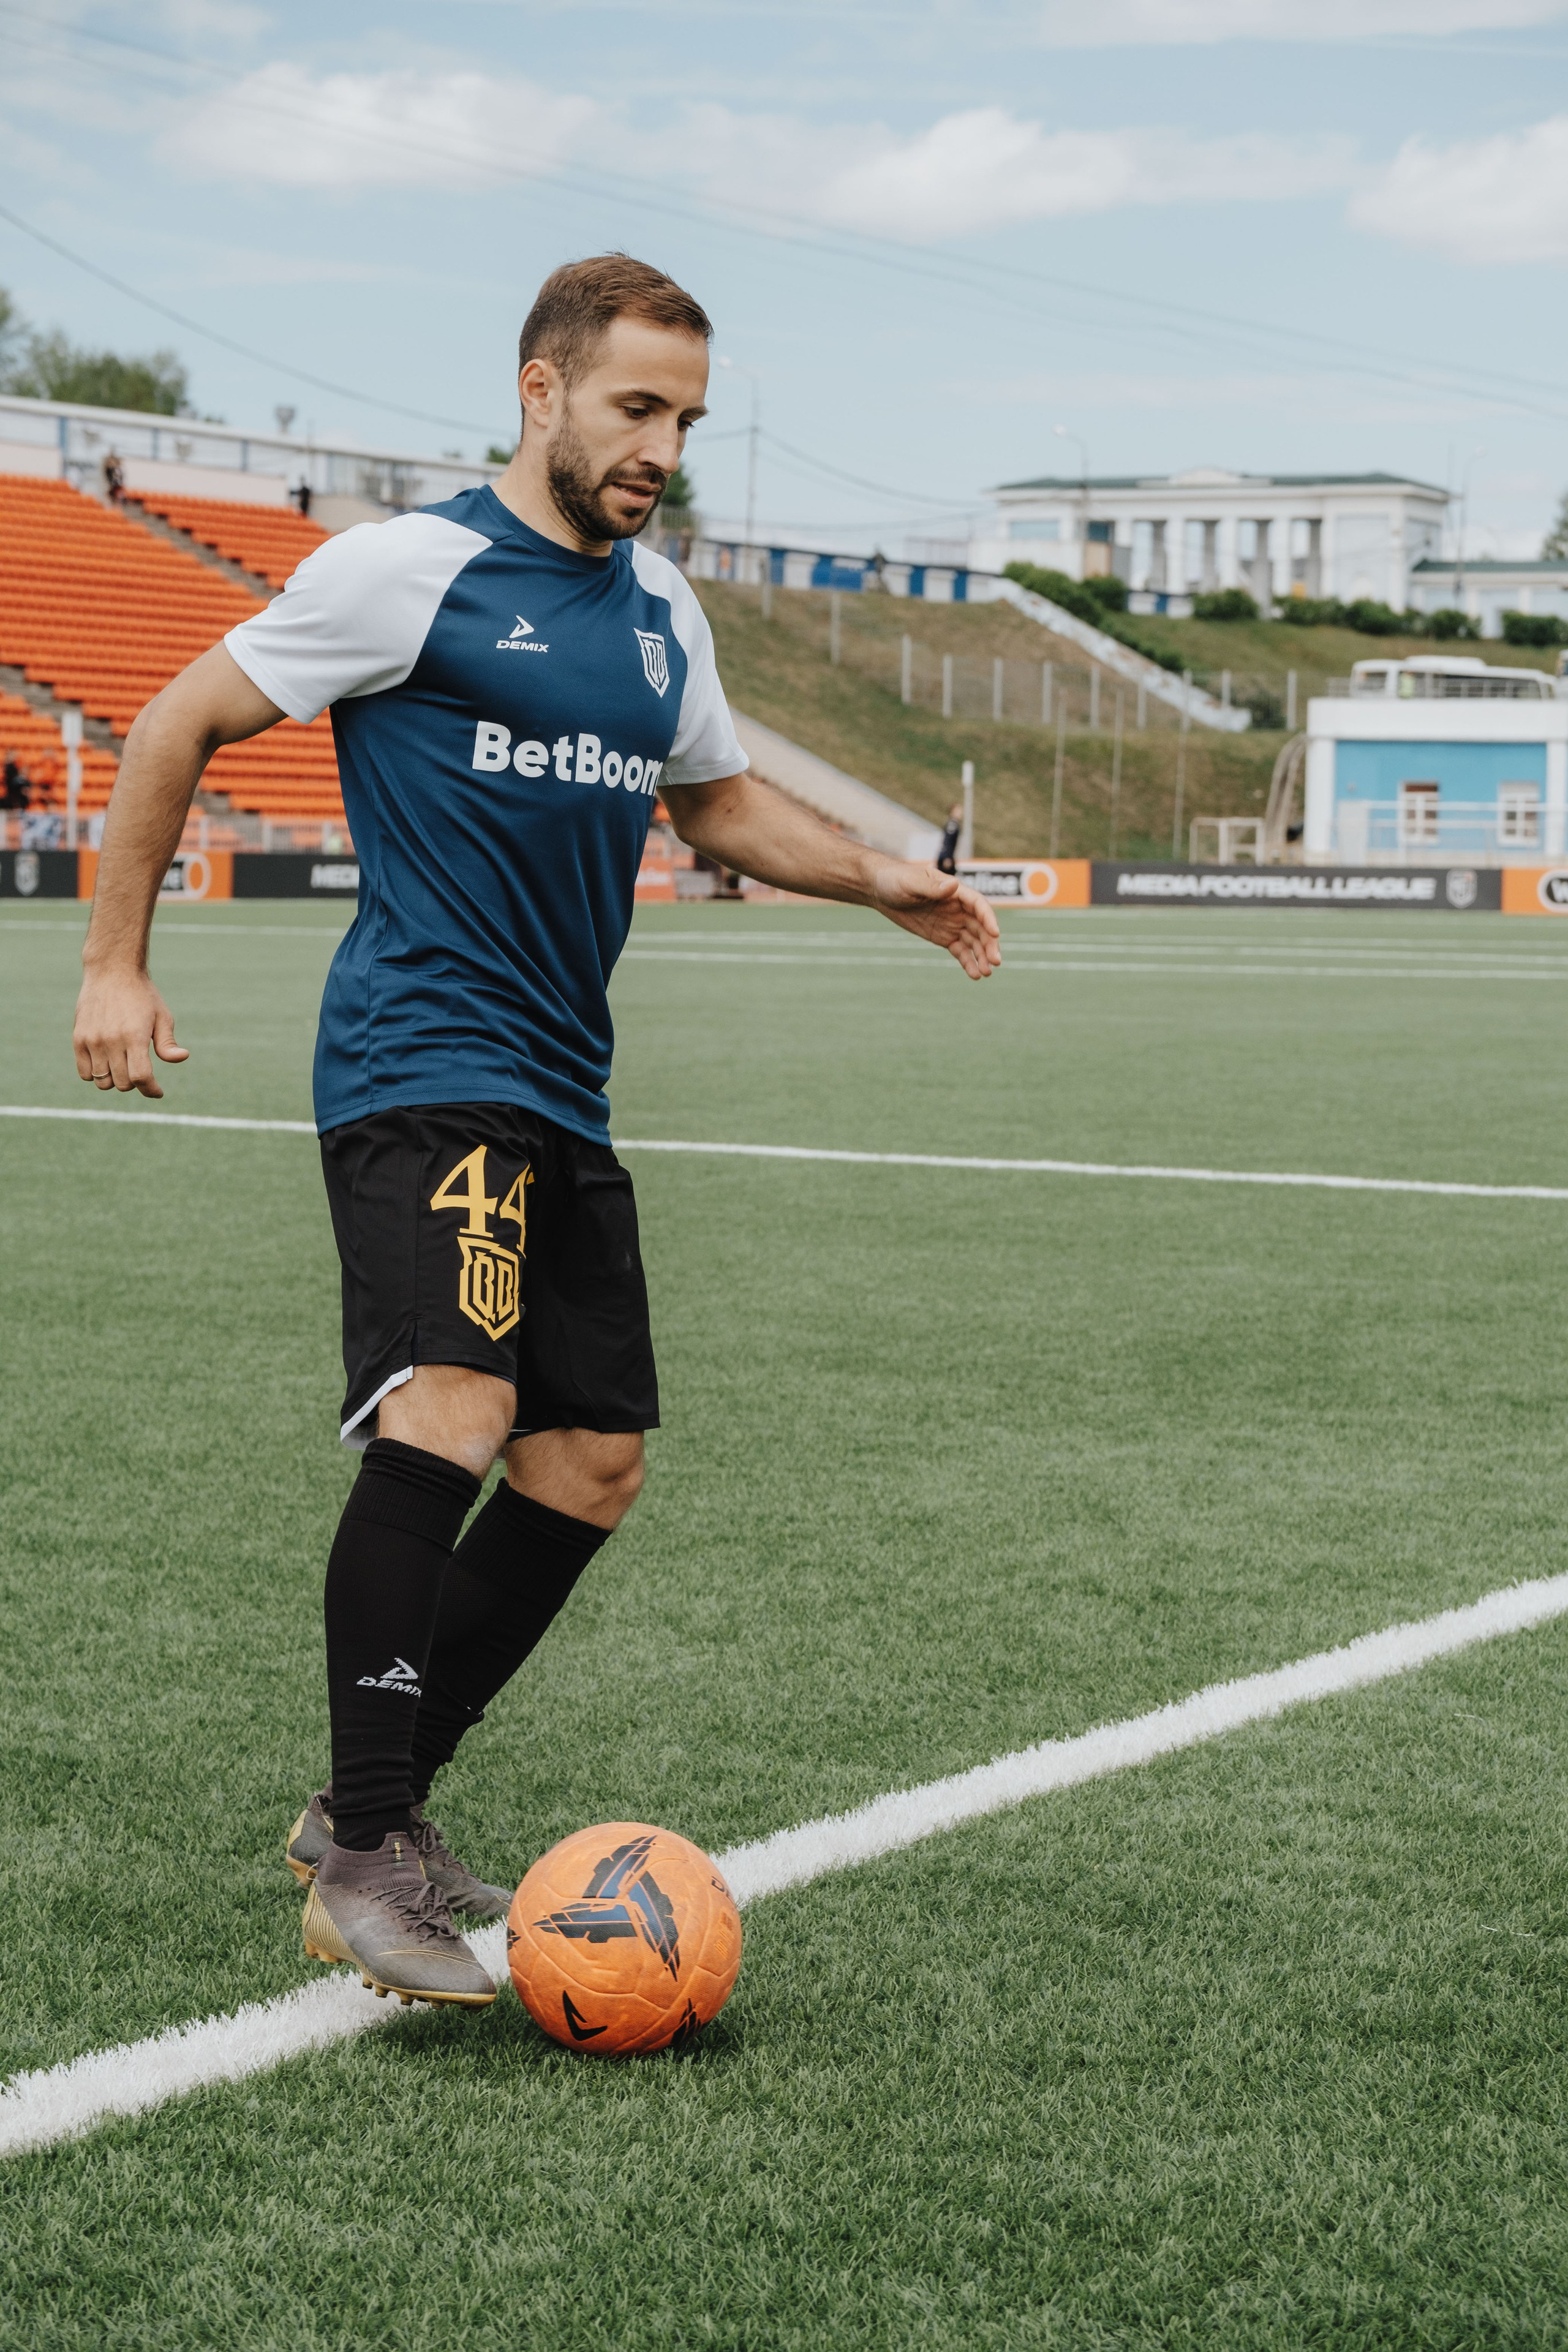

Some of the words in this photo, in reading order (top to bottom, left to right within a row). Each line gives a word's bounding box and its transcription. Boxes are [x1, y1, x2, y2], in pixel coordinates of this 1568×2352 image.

[496, 639, 549, 654] DEMIX
[472, 721, 663, 796] BetBoom
[1117, 873, 1199, 897] MEDIA
[1199, 875, 1330, 899] FOOTBALL
[1331, 876, 1435, 900] LEAGUE
[356, 1676, 422, 1698] DEMIX
